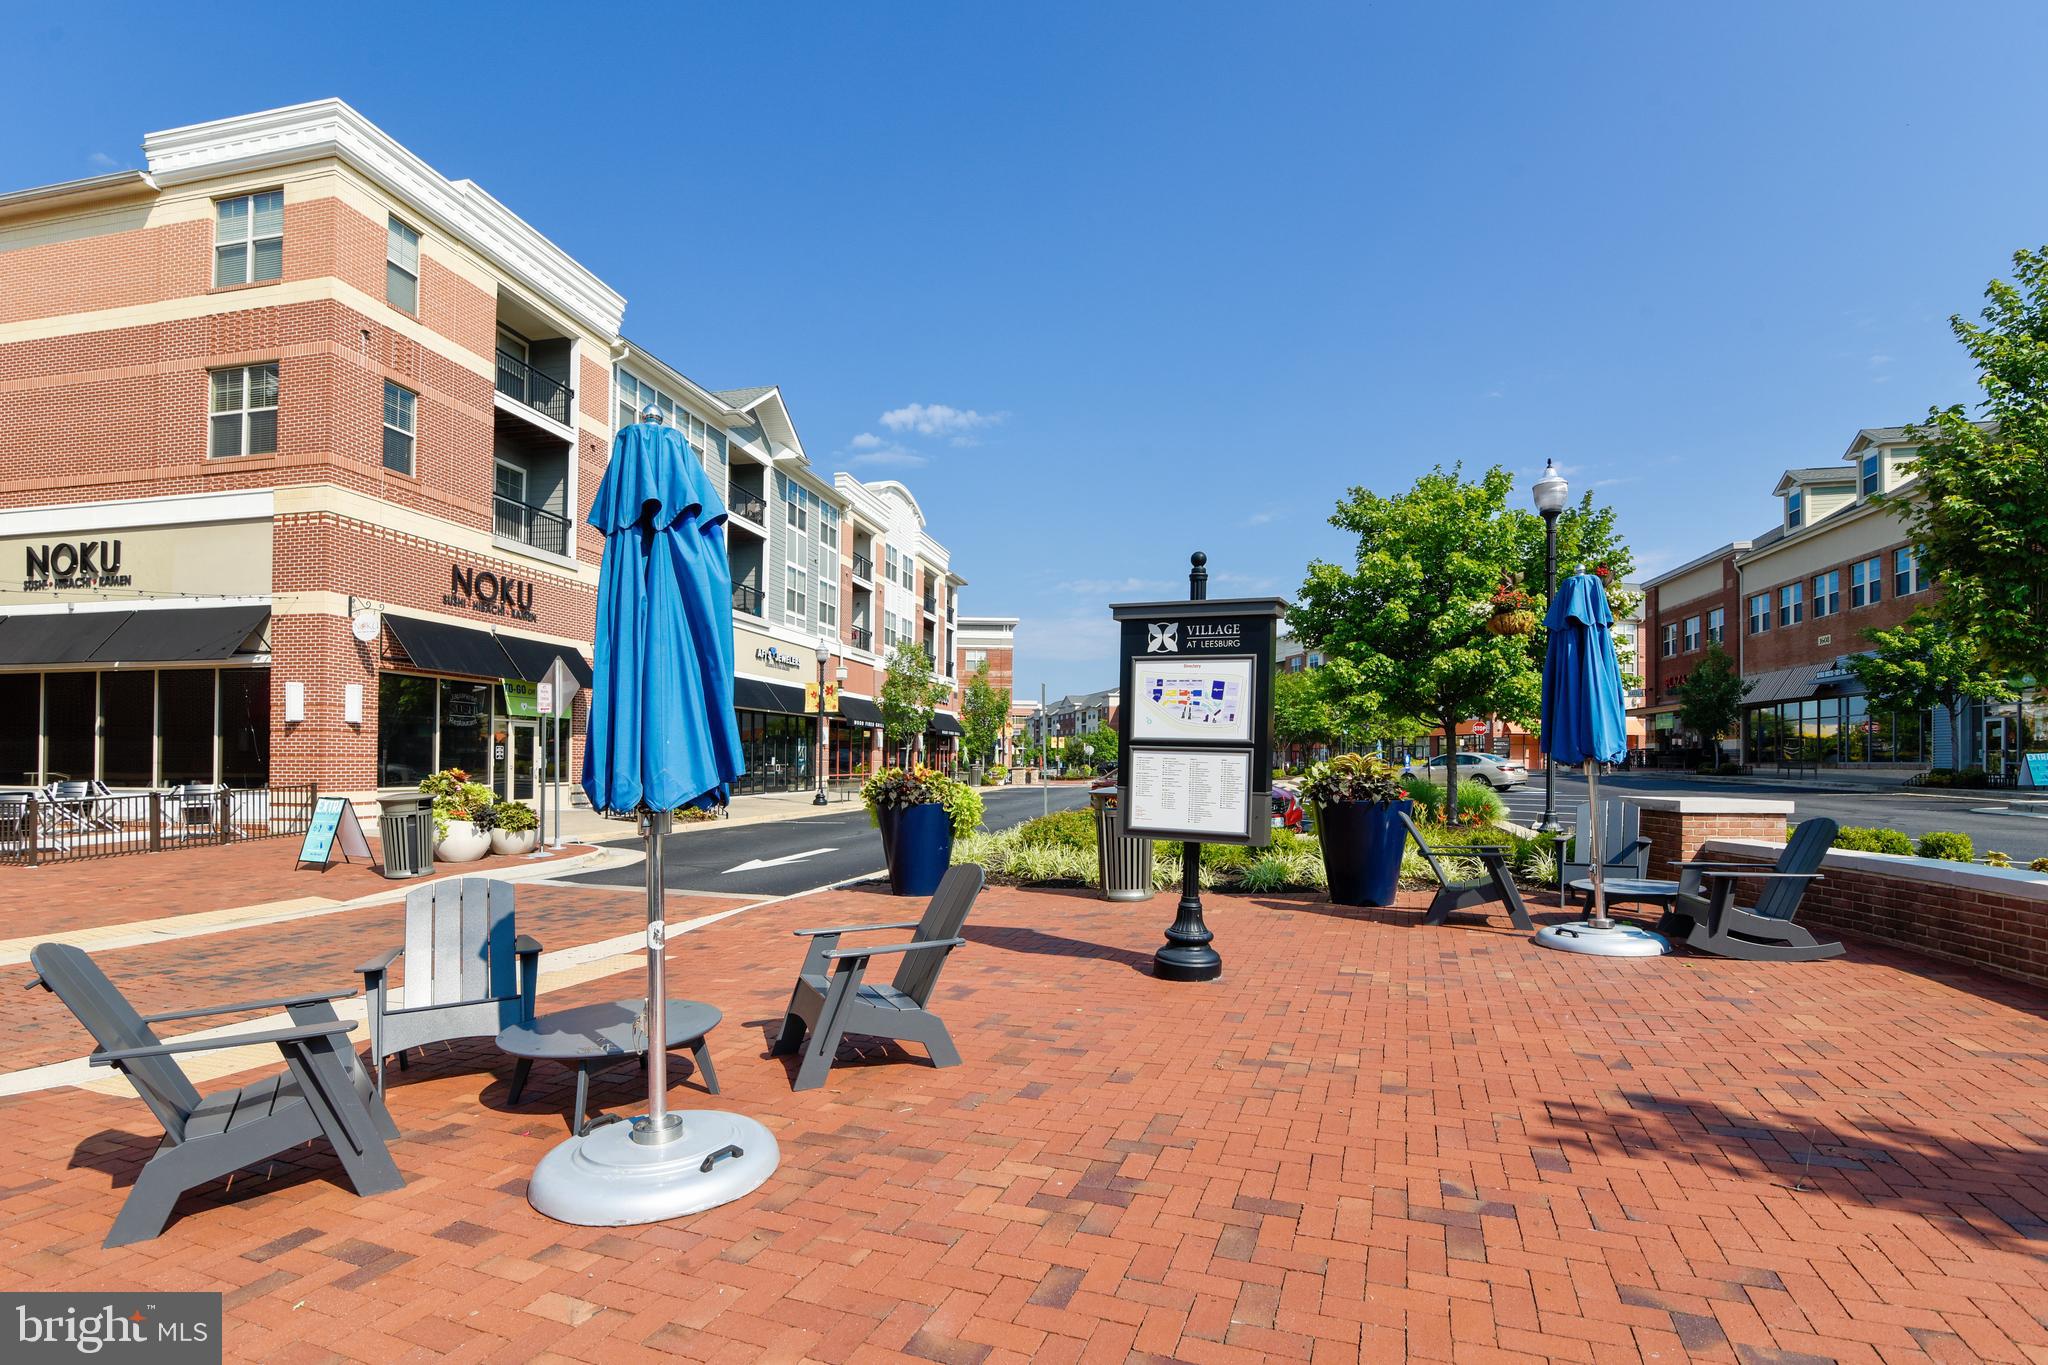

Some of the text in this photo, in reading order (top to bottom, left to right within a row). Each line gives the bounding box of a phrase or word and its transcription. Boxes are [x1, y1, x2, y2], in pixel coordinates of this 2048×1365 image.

[26, 539, 121, 578] NOKU
[23, 574, 132, 592] SUSHI HIBACHI RAMEN
[451, 564, 533, 611] NOKU
[443, 594, 466, 609] SUSHI
[472, 600, 505, 617] HIBACHI
[1186, 623, 1241, 636] VILLAGE
[1186, 639, 1241, 649] AT LEESBURG
